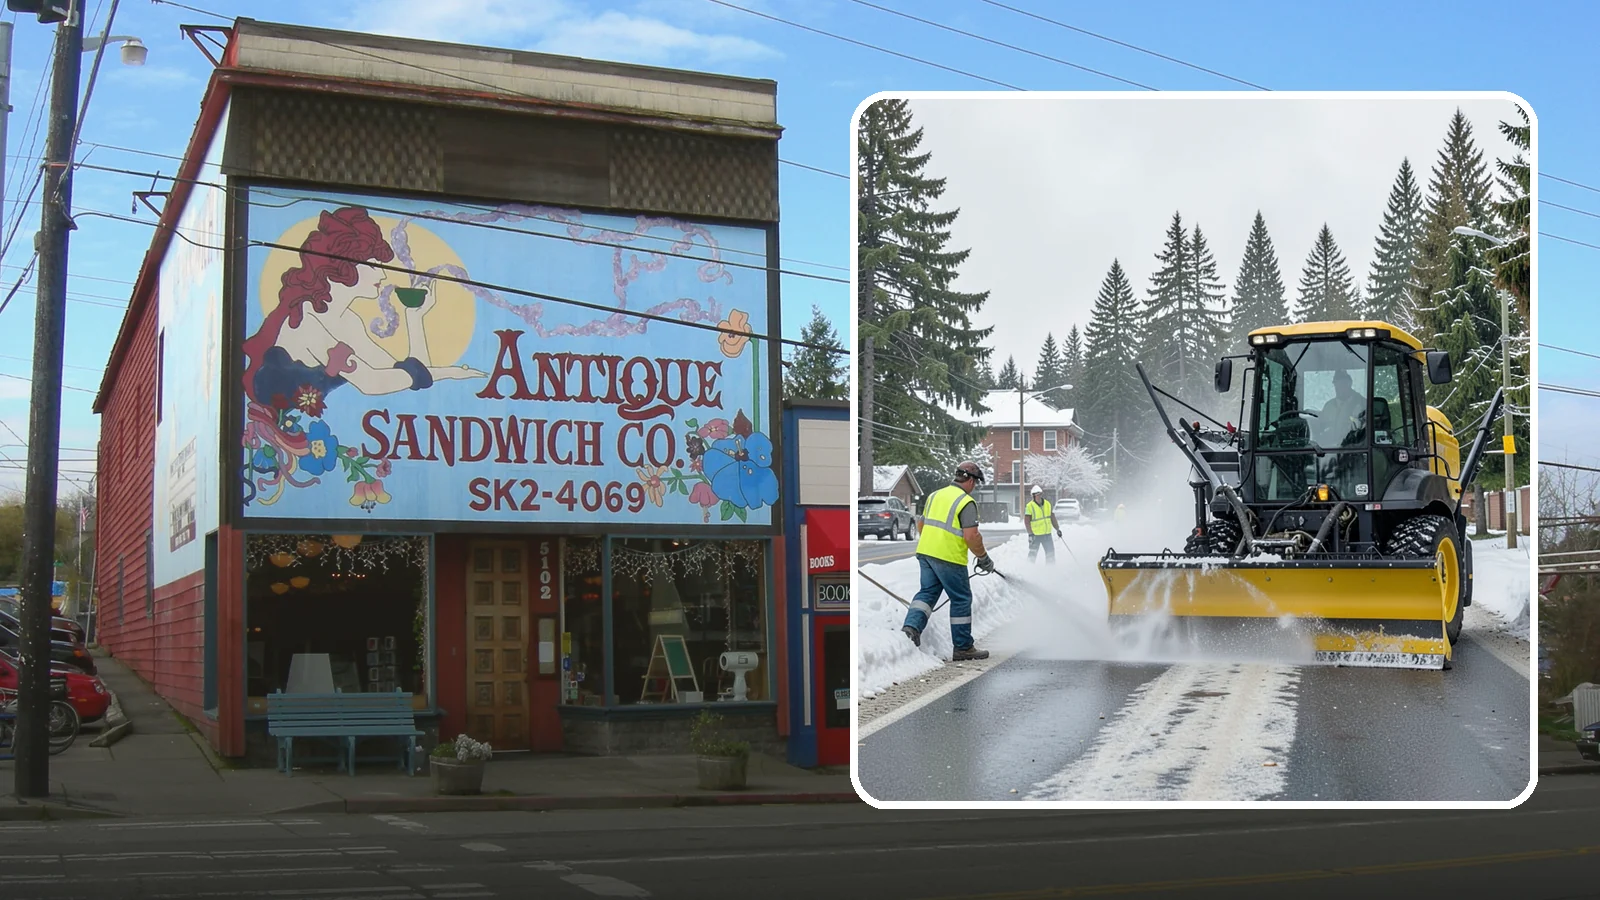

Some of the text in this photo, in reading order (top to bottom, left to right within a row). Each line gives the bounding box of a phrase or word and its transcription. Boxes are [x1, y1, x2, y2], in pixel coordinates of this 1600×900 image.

[476, 329, 724, 421] ANTIQUE
[361, 408, 685, 468] SANDWICH CO.
[468, 477, 645, 513] SK2-4069
[539, 542, 551, 599] 5102
[809, 555, 835, 569] BOOKS
